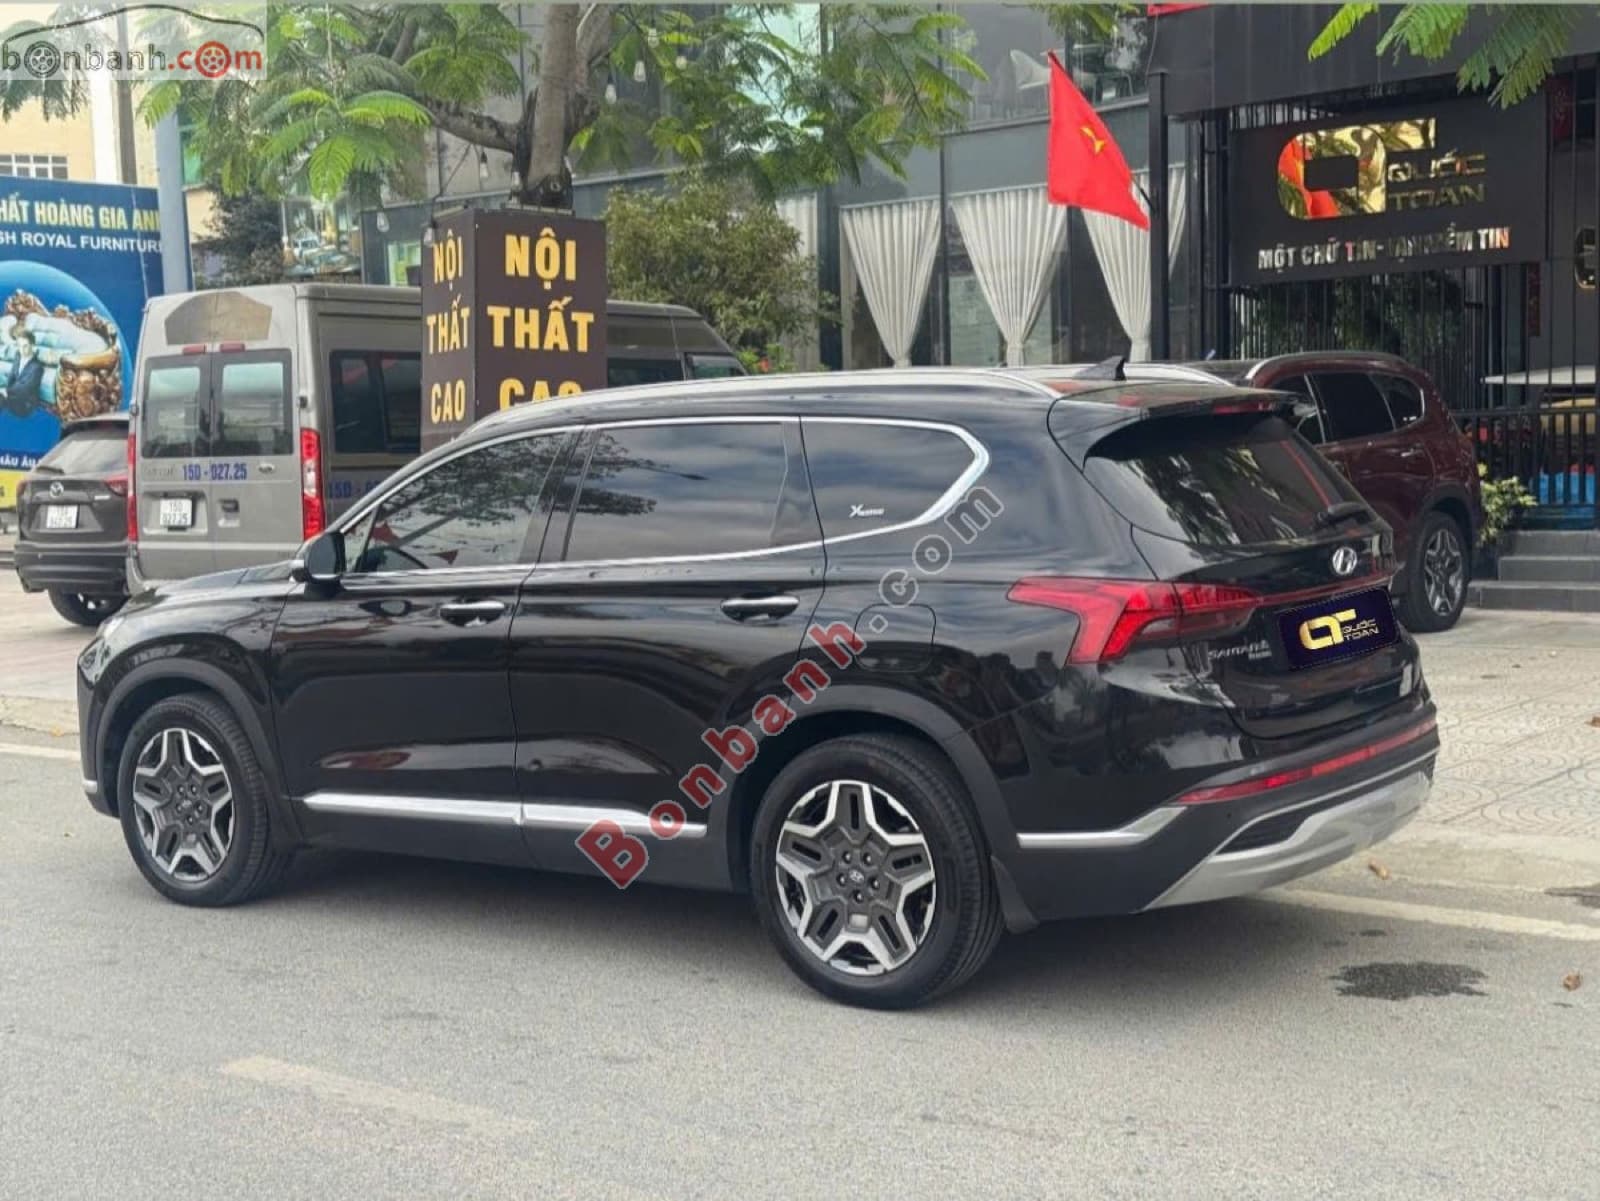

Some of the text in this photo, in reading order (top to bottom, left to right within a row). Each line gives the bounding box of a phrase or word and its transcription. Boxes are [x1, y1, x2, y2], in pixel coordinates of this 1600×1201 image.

[34, 197, 95, 229] HOÀNG
[100, 205, 128, 230] GIA
[21, 231, 77, 249] ROYAL
[80, 234, 162, 253] FURNITUR
[433, 229, 464, 291] NỘI
[504, 227, 577, 290] NỘI
[1258, 242, 1296, 274] MỘT
[1477, 226, 1511, 250] TIN
[426, 294, 470, 355] THẤT
[486, 296, 595, 353] THẤT
[430, 379, 466, 425] CAO
